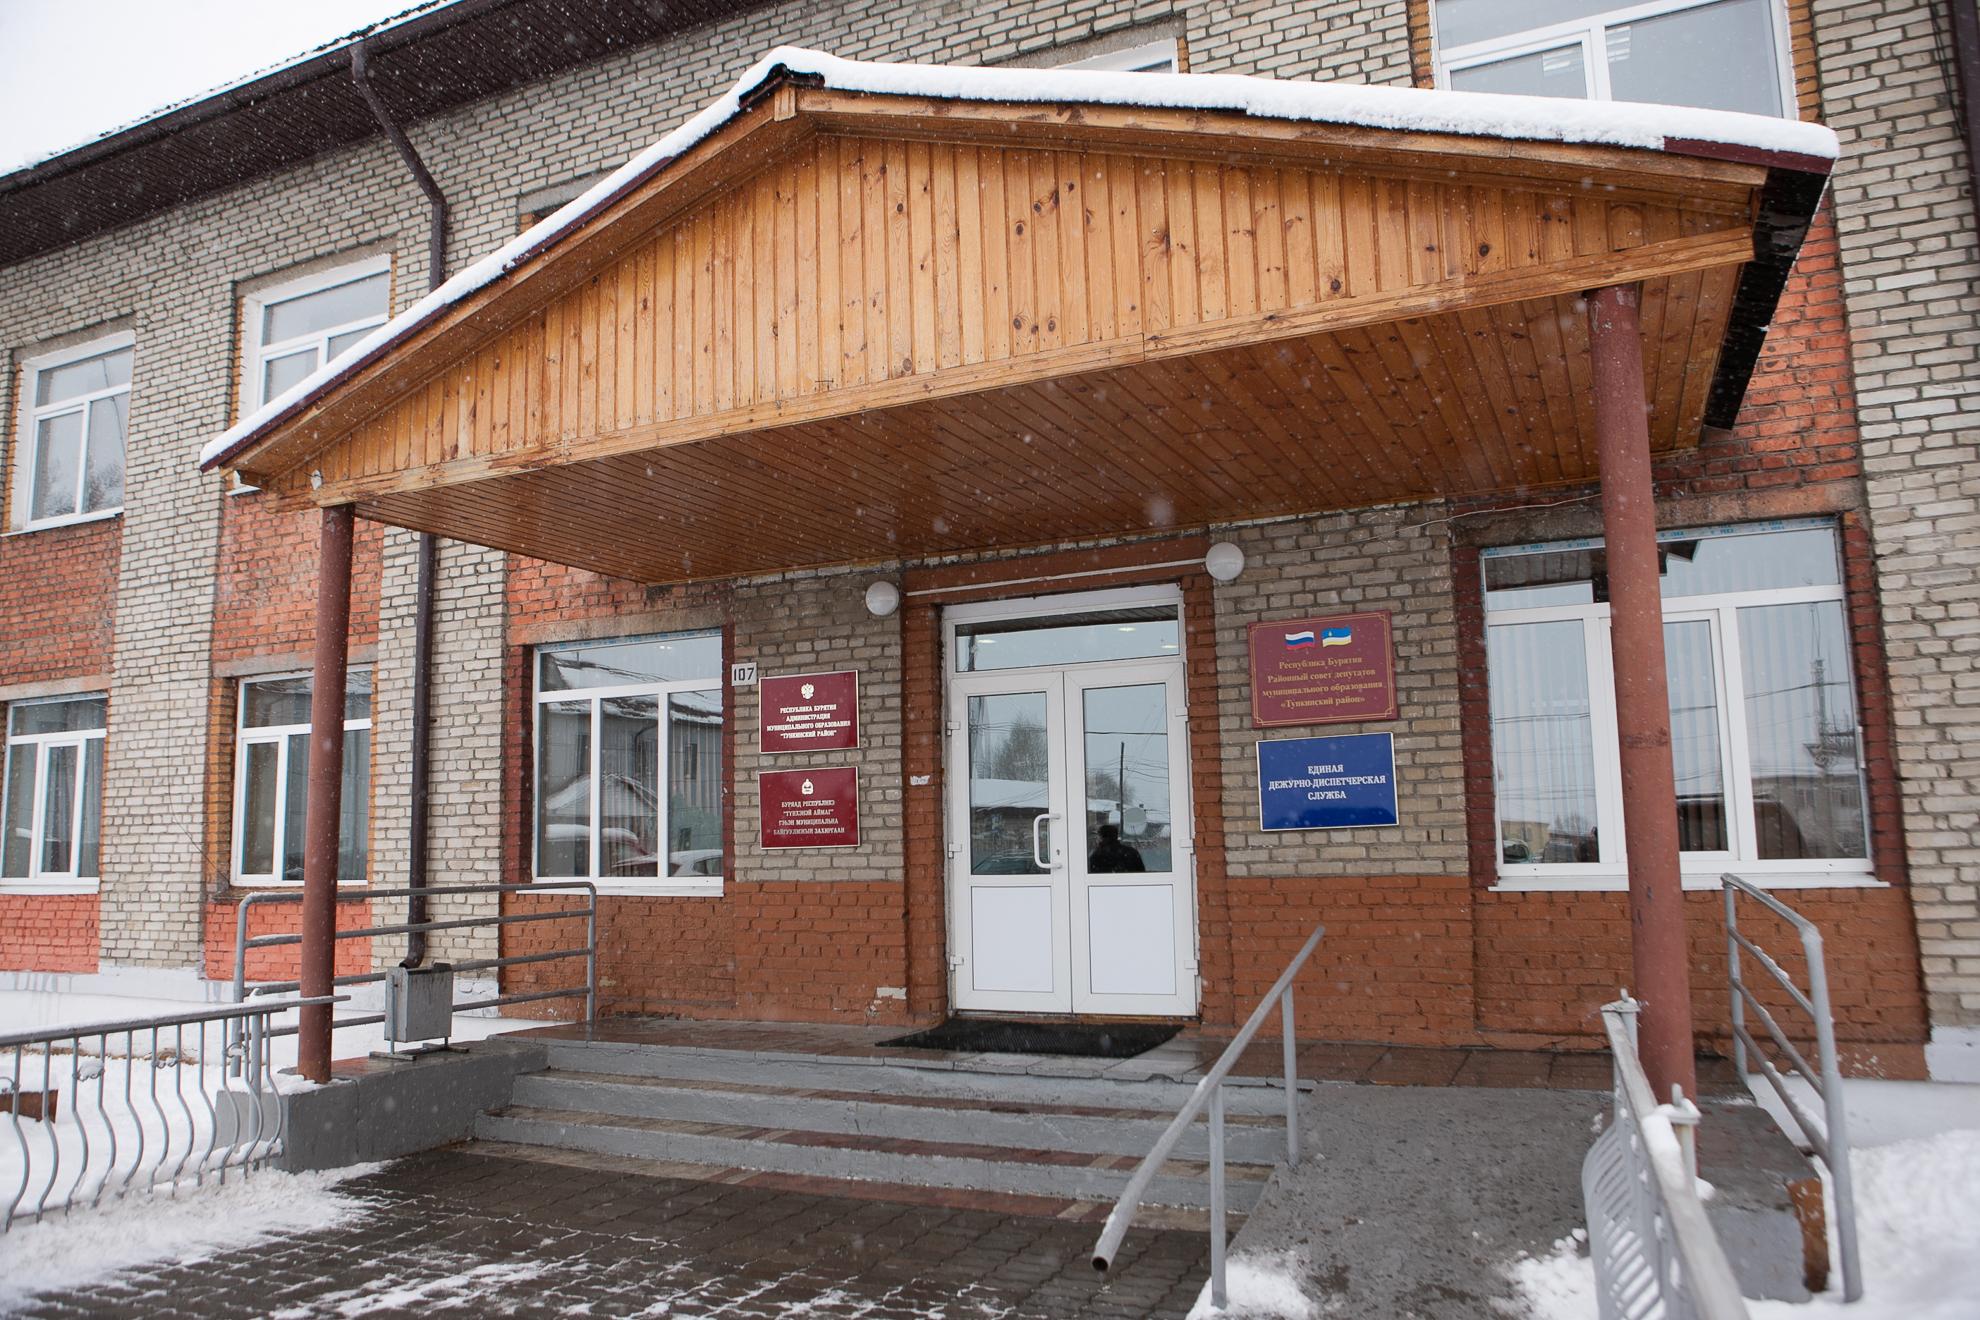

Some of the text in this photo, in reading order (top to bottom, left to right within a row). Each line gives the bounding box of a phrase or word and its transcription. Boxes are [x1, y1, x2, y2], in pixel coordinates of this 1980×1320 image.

[1279, 657, 1362, 670] Республика Бурятия
[734, 668, 754, 681] 107
[1268, 669, 1376, 683] Районный совет депутатов
[1263, 681, 1382, 697] муниципального образования
[786, 713, 831, 722] АДМИНИСТРАЦИЯ
[767, 720, 850, 732] МУНИЦИПАЛЬНОГО ОБРАЗОВАНИЯ
[1308, 764, 1344, 775] ЕДИНАЯ
[1269, 775, 1386, 790] ДЕЖУРНО-ДИСПЕТЧЕРСКАЯ
[1308, 791, 1346, 800] СЛУЖБА
